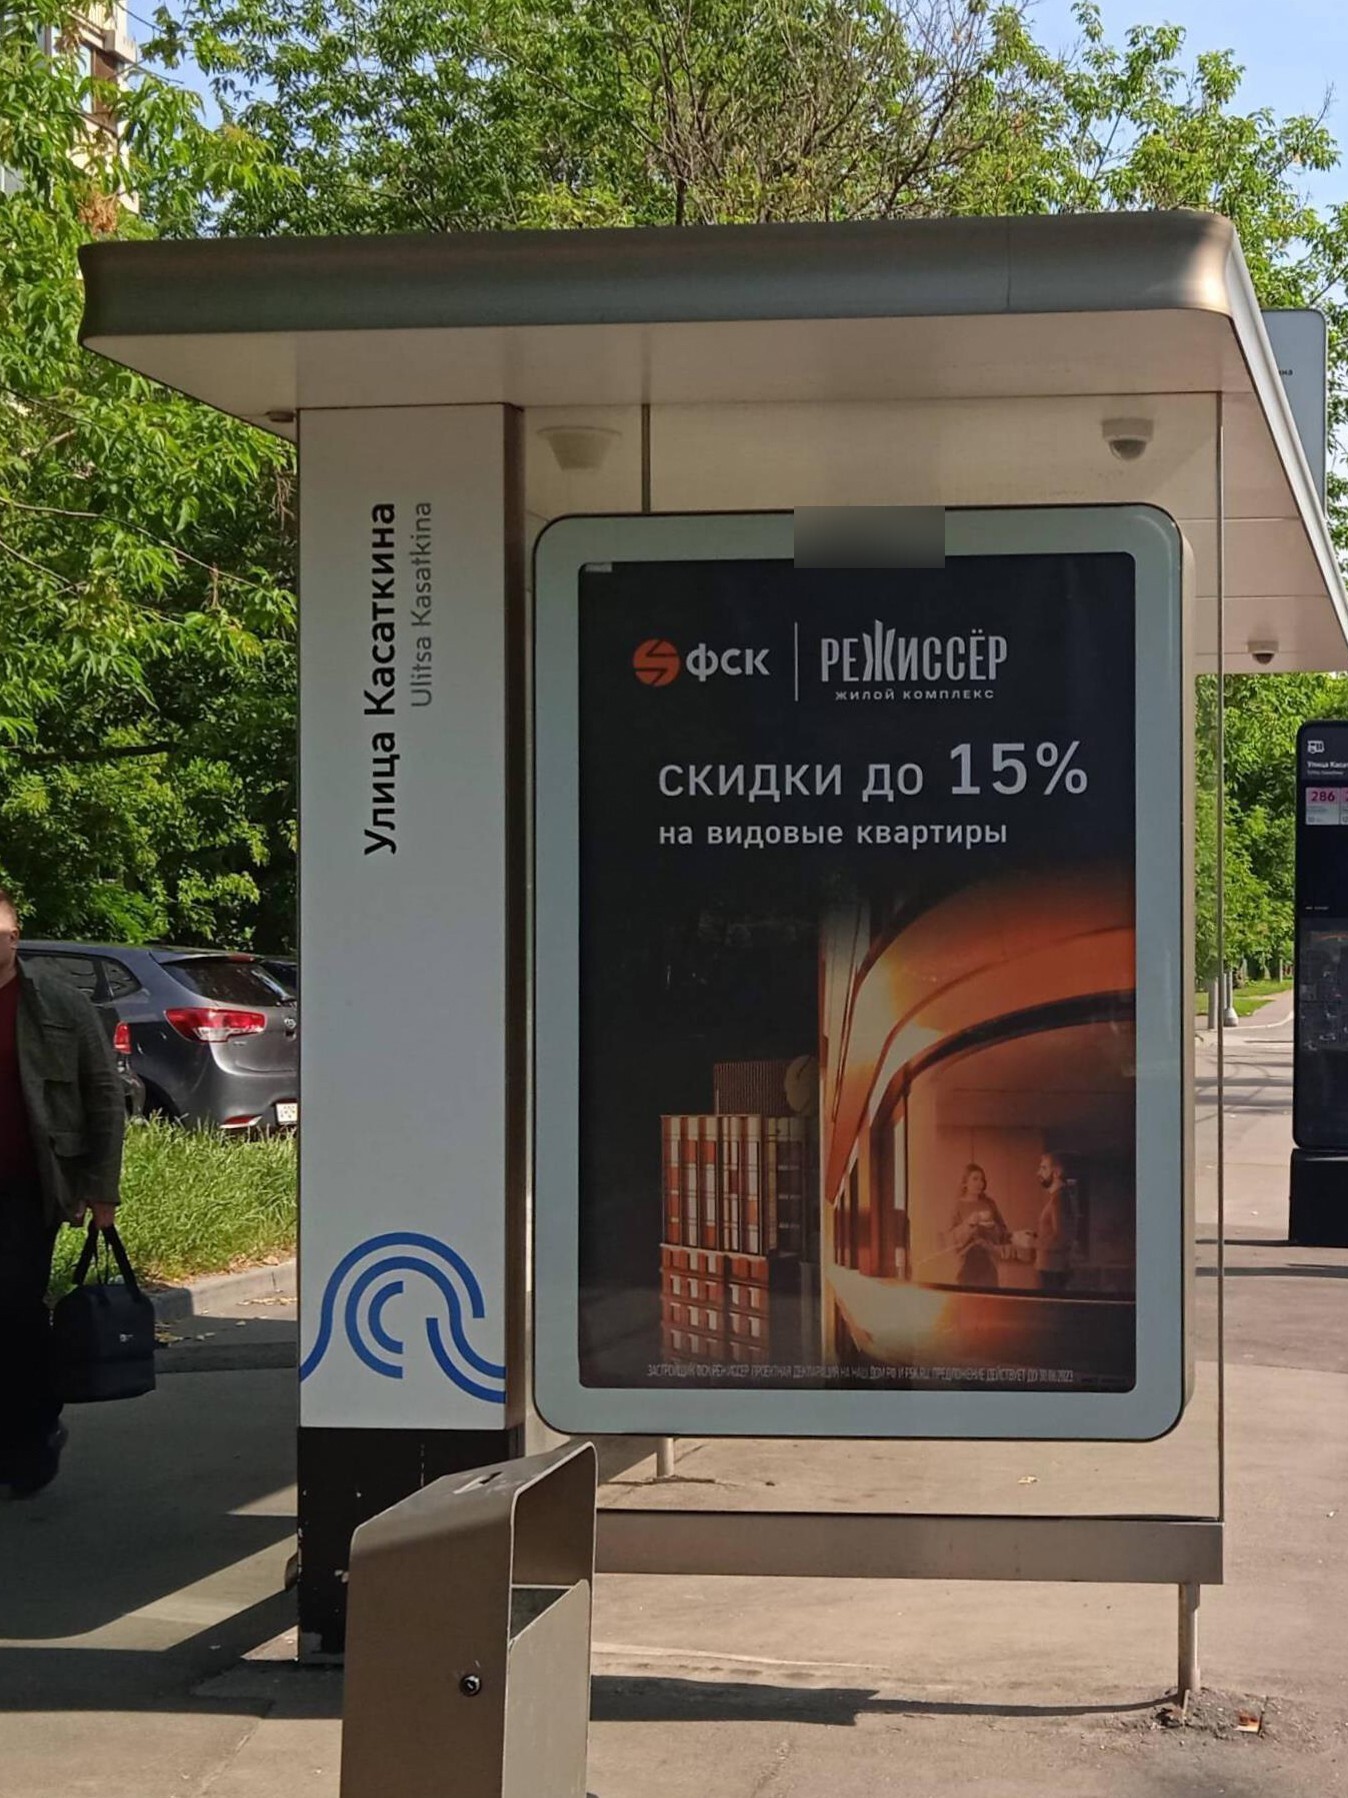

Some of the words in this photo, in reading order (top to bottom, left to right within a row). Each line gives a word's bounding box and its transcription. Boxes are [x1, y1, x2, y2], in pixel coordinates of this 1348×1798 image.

[409, 501, 433, 628] Kasatkina
[364, 502, 396, 715] Касаткина
[409, 635, 433, 708] Ulitsa
[820, 619, 1008, 683] РЕЖИССЁР
[834, 688, 895, 701] ЖИЛОЙ
[903, 688, 996, 700] КОМПЛЕКС
[364, 732, 400, 855] Улица
[949, 740, 1089, 797] 15%
[1311, 790, 1336, 802] 286
[658, 823, 694, 845] на
[707, 823, 844, 851] видовые
[857, 822, 1008, 851] квартиры
